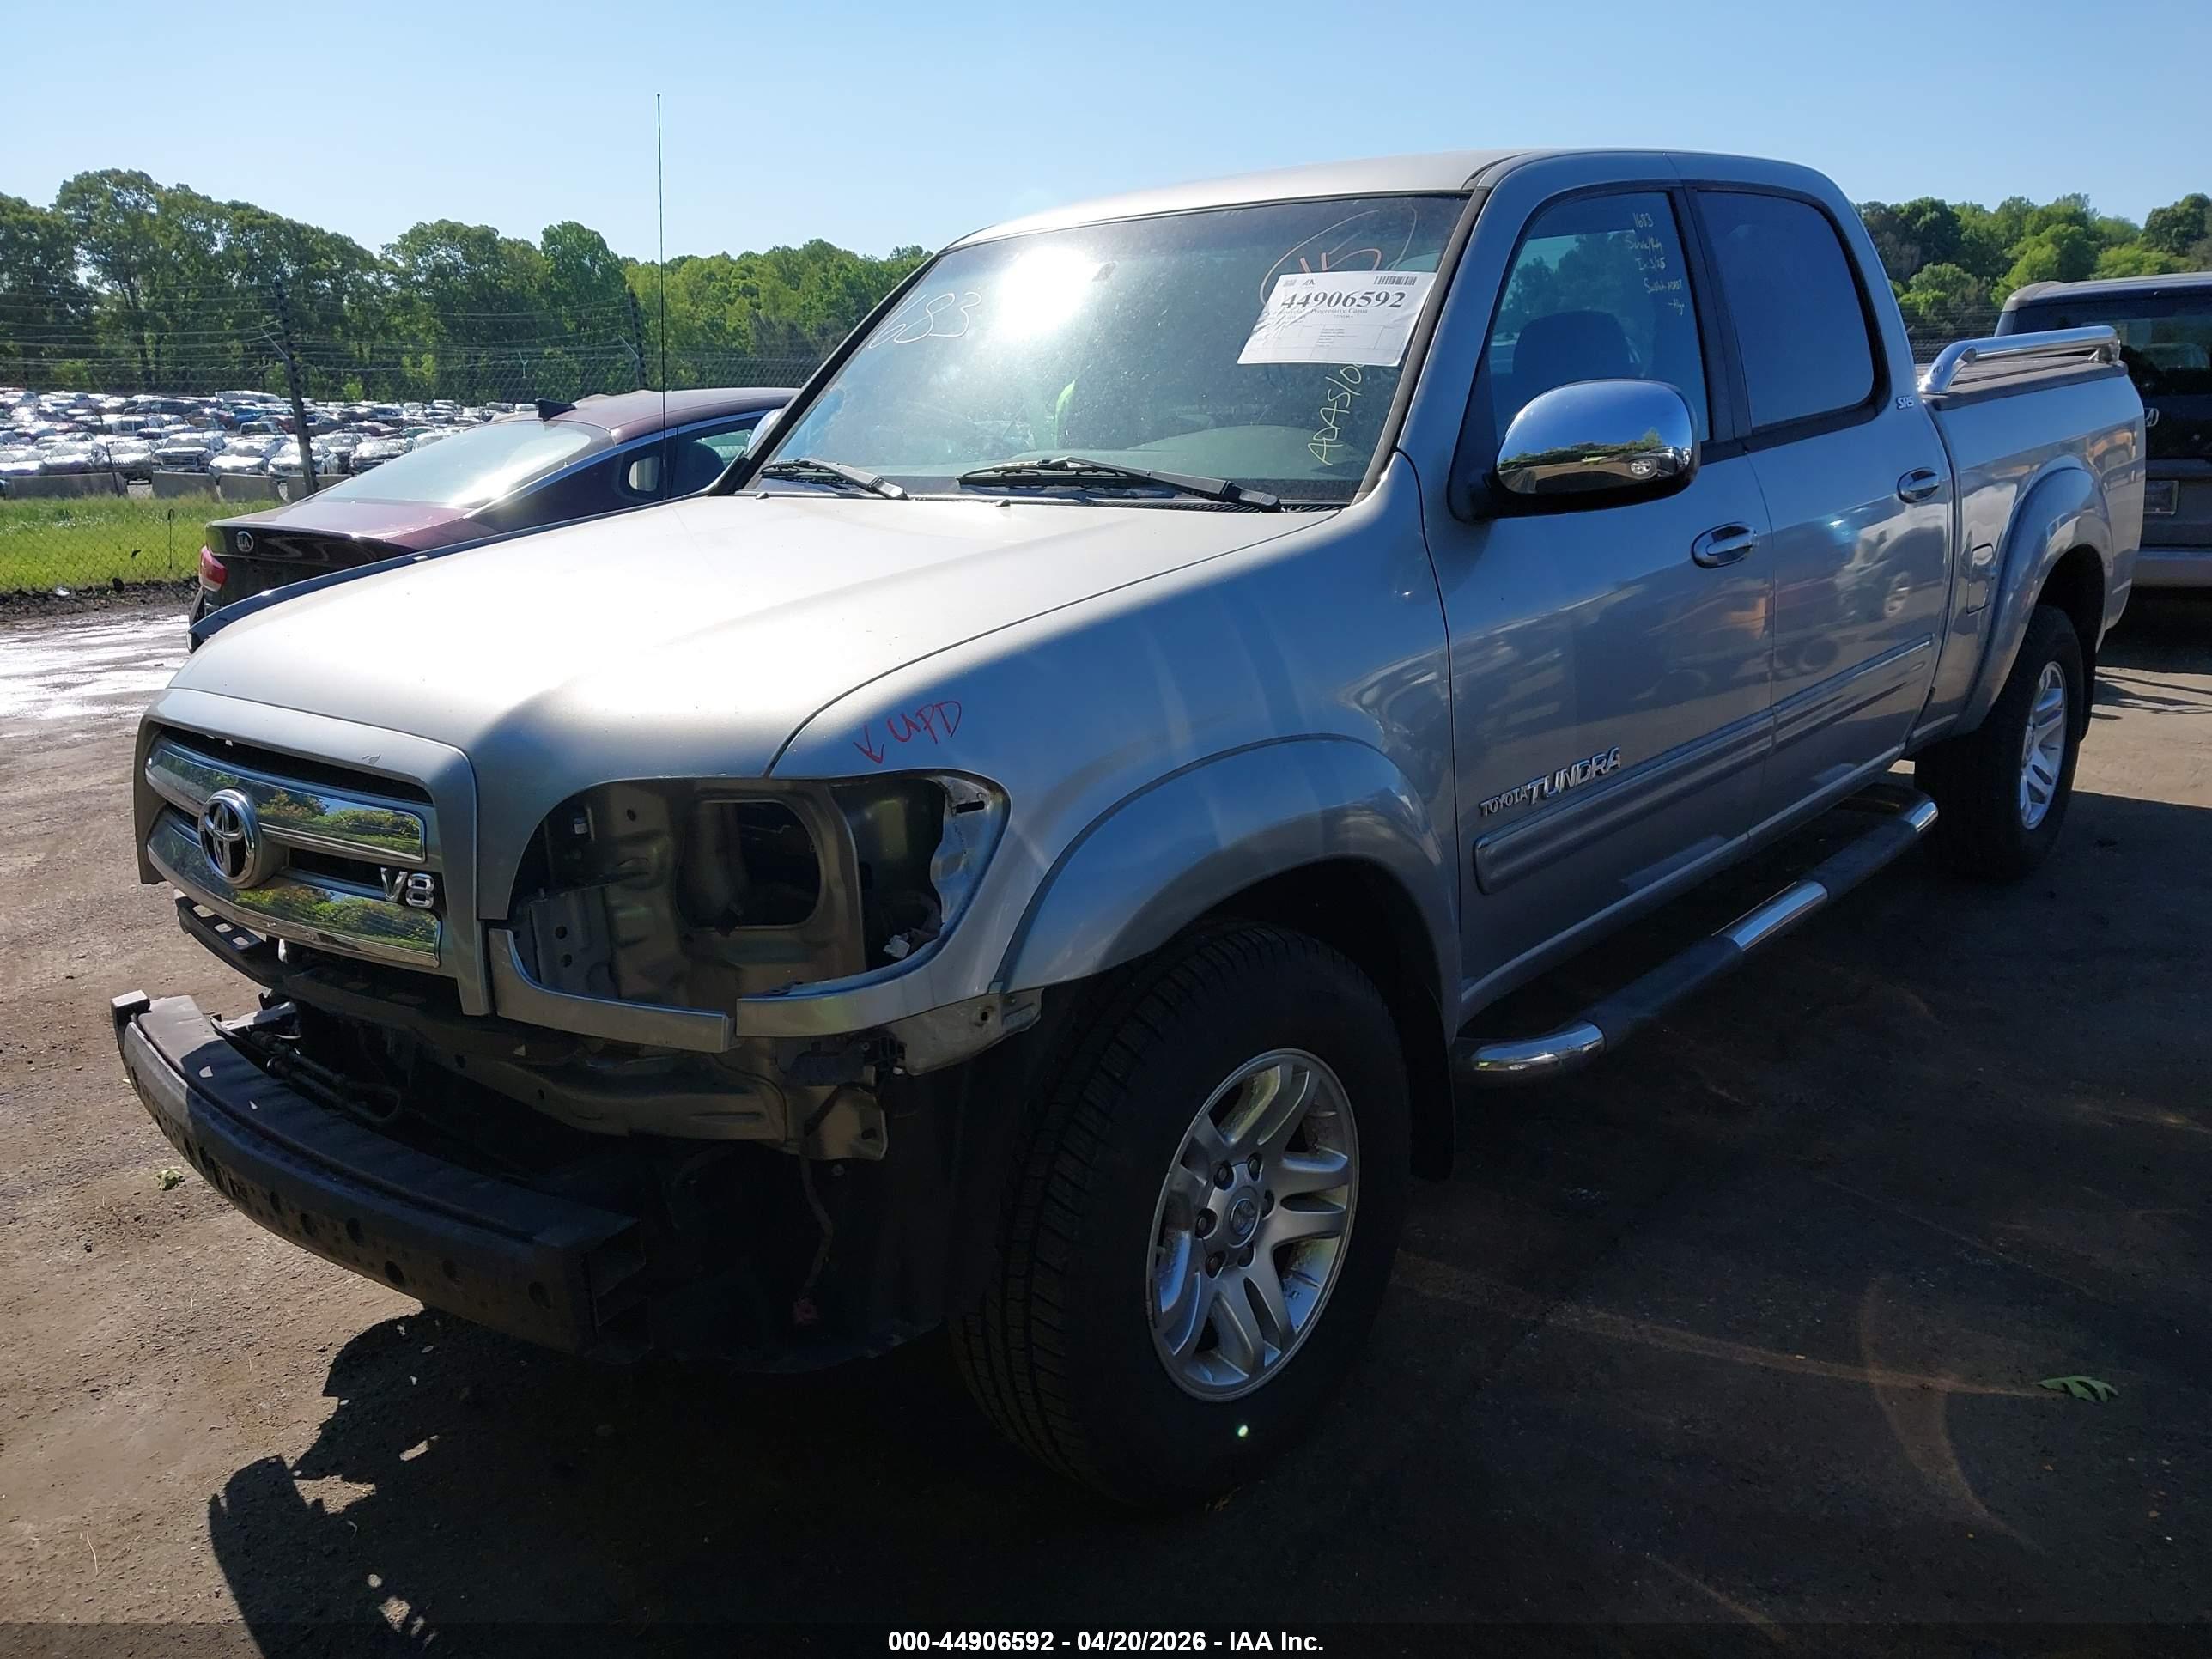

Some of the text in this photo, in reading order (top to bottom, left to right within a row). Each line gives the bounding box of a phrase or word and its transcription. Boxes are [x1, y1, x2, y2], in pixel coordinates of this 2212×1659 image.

[1281, 290, 1407, 309] 44906592
[887, 700, 962, 745] UPD
[1480, 746, 1622, 817] TOYOTA TUNDRA
[380, 866, 434, 908] V8
